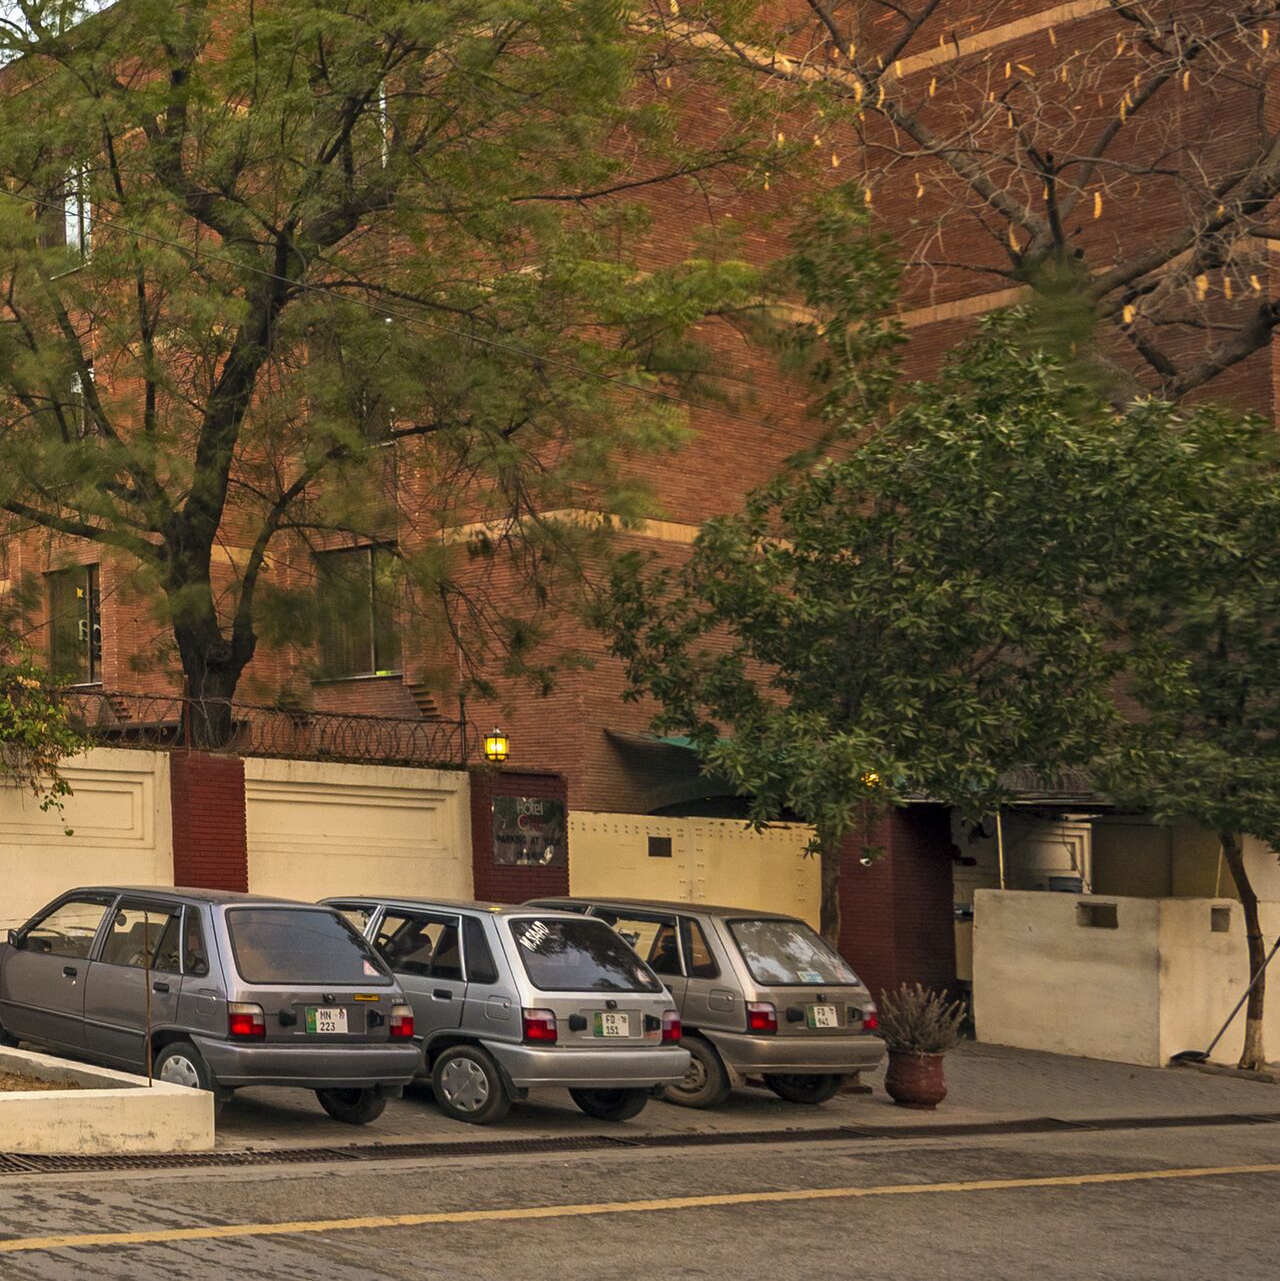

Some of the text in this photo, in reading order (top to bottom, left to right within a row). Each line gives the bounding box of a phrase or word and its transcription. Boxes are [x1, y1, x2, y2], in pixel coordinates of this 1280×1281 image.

[517, 802, 543, 815] Hotel
[605, 1014, 616, 1024] FD
[320, 1022, 335, 1032] 223
[605, 1025, 619, 1035] 151
